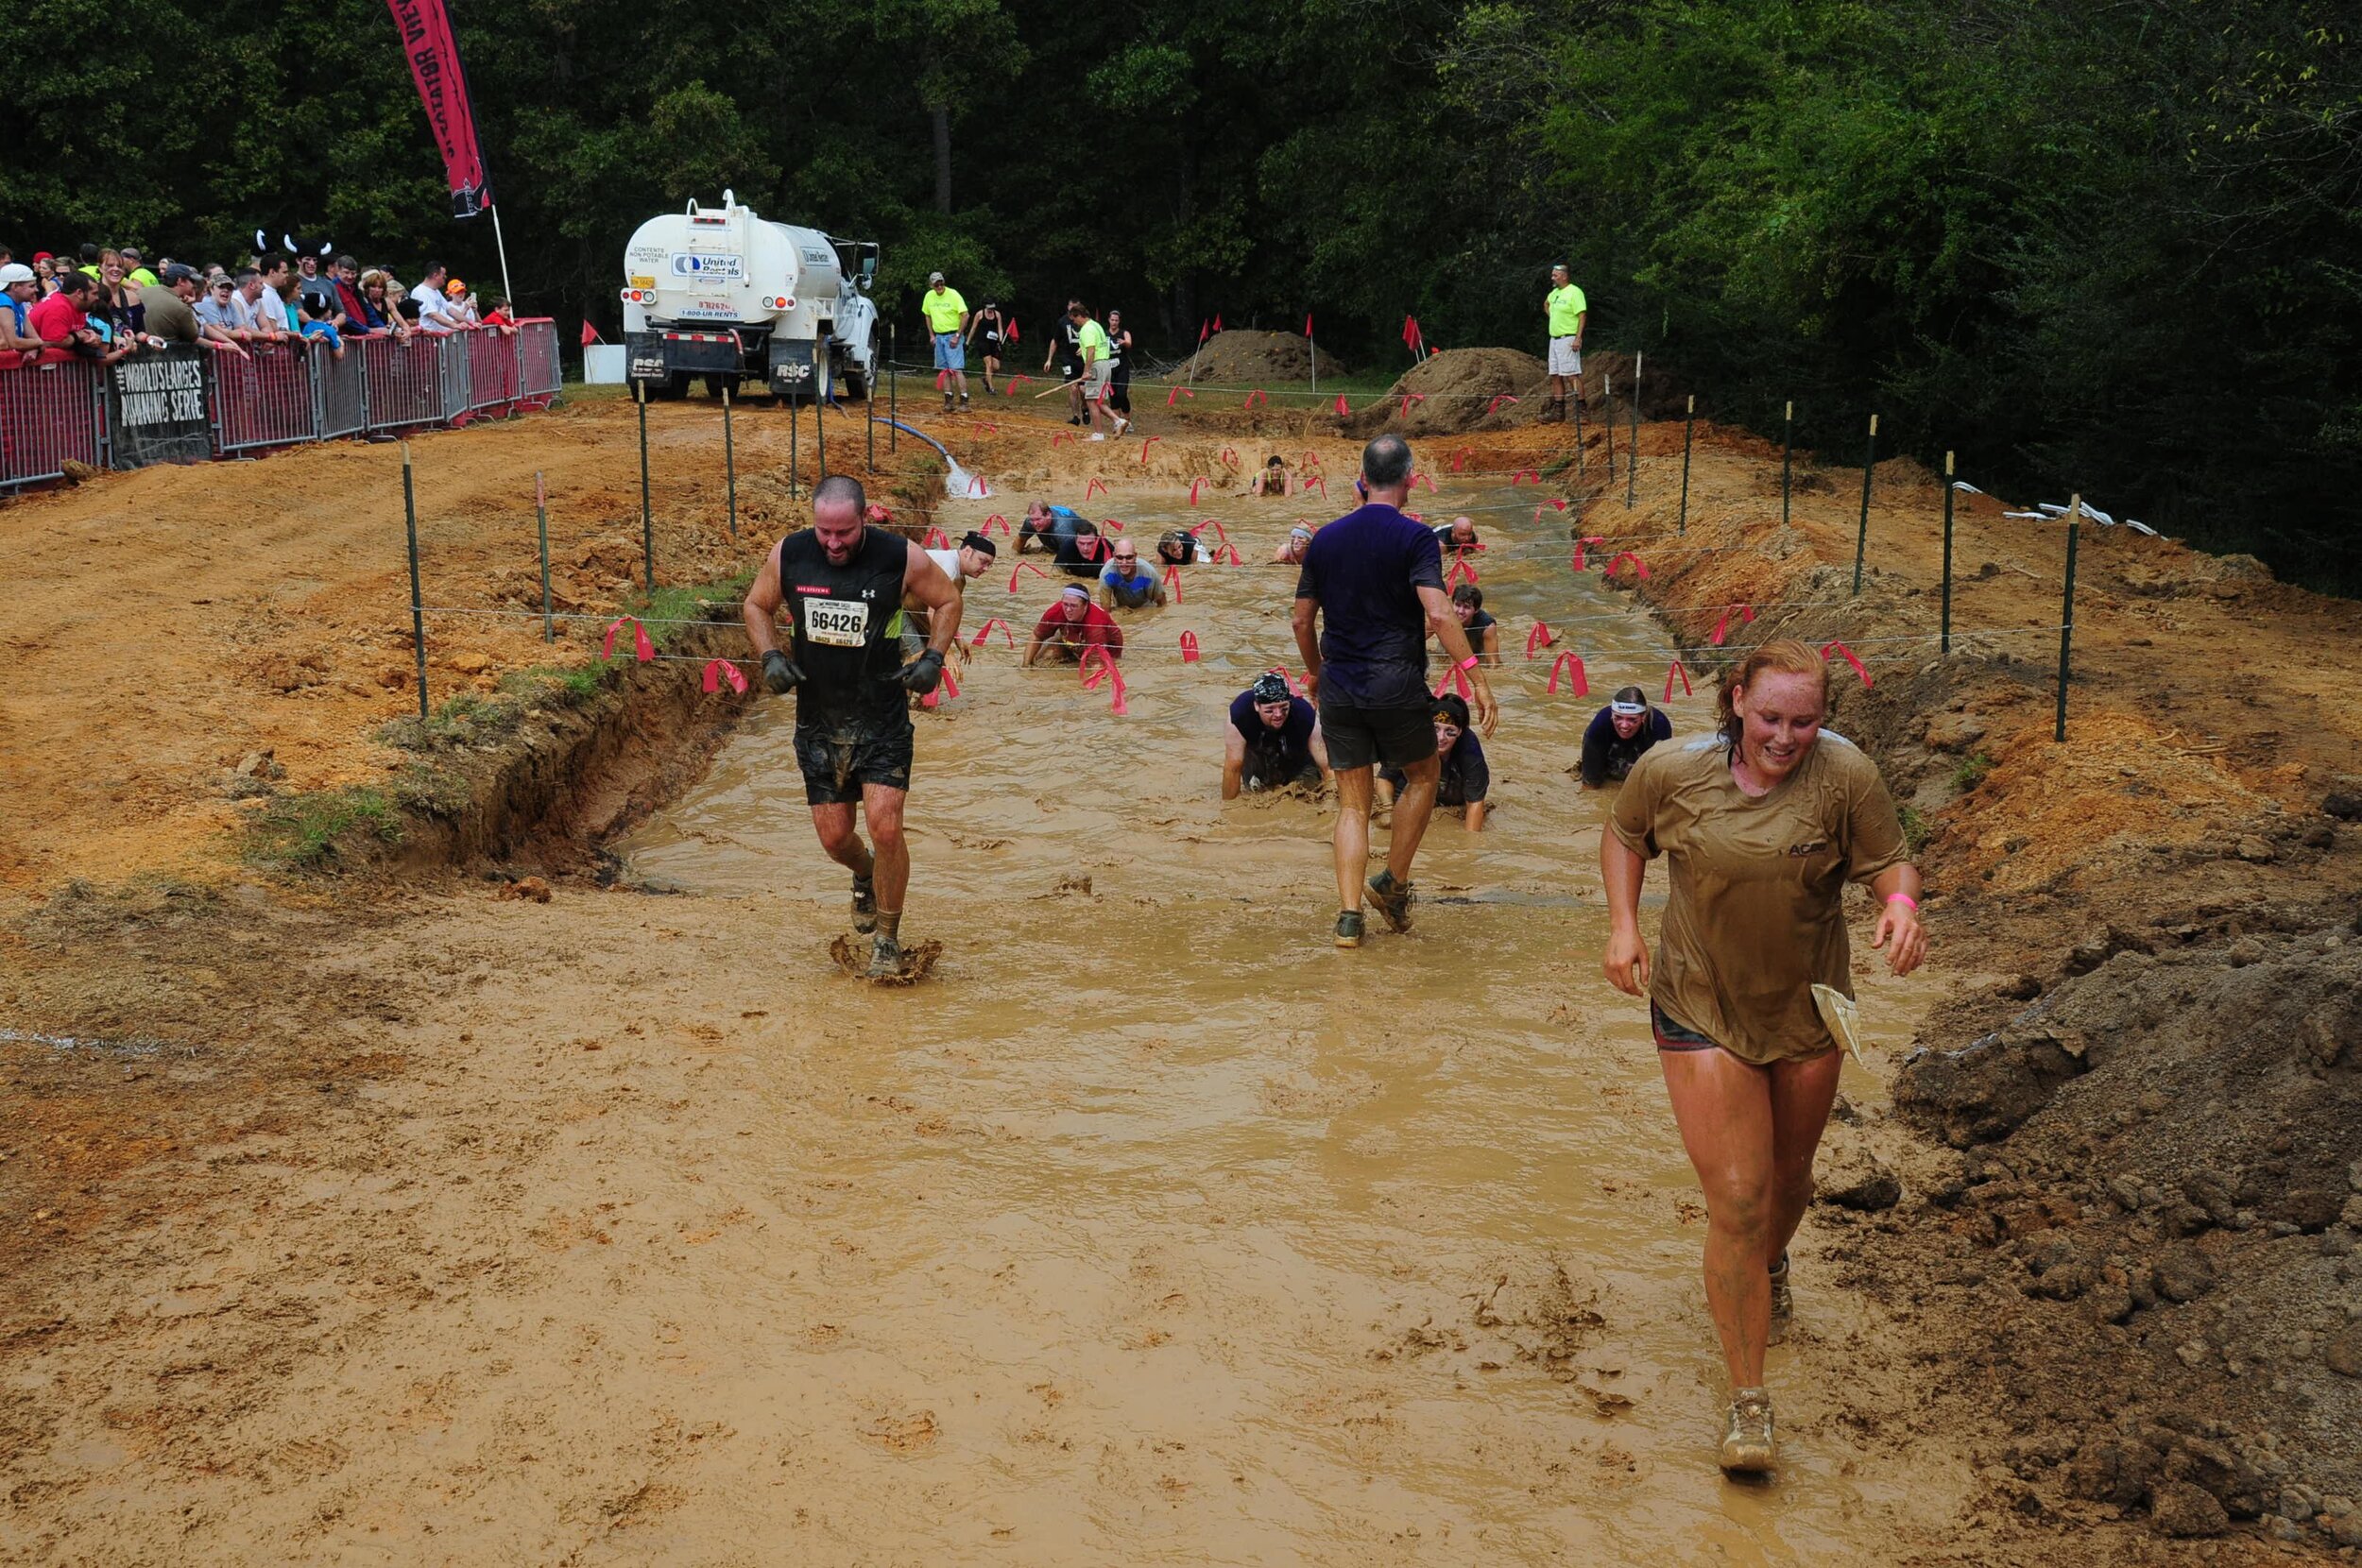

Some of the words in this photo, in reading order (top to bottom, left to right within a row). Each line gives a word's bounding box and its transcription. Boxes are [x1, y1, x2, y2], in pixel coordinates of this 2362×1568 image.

[702, 257, 737, 266] United
[115, 365, 126, 393] THE
[777, 364, 810, 378] RSC
[121, 391, 169, 427] RUNNING
[812, 610, 862, 633] 66426
